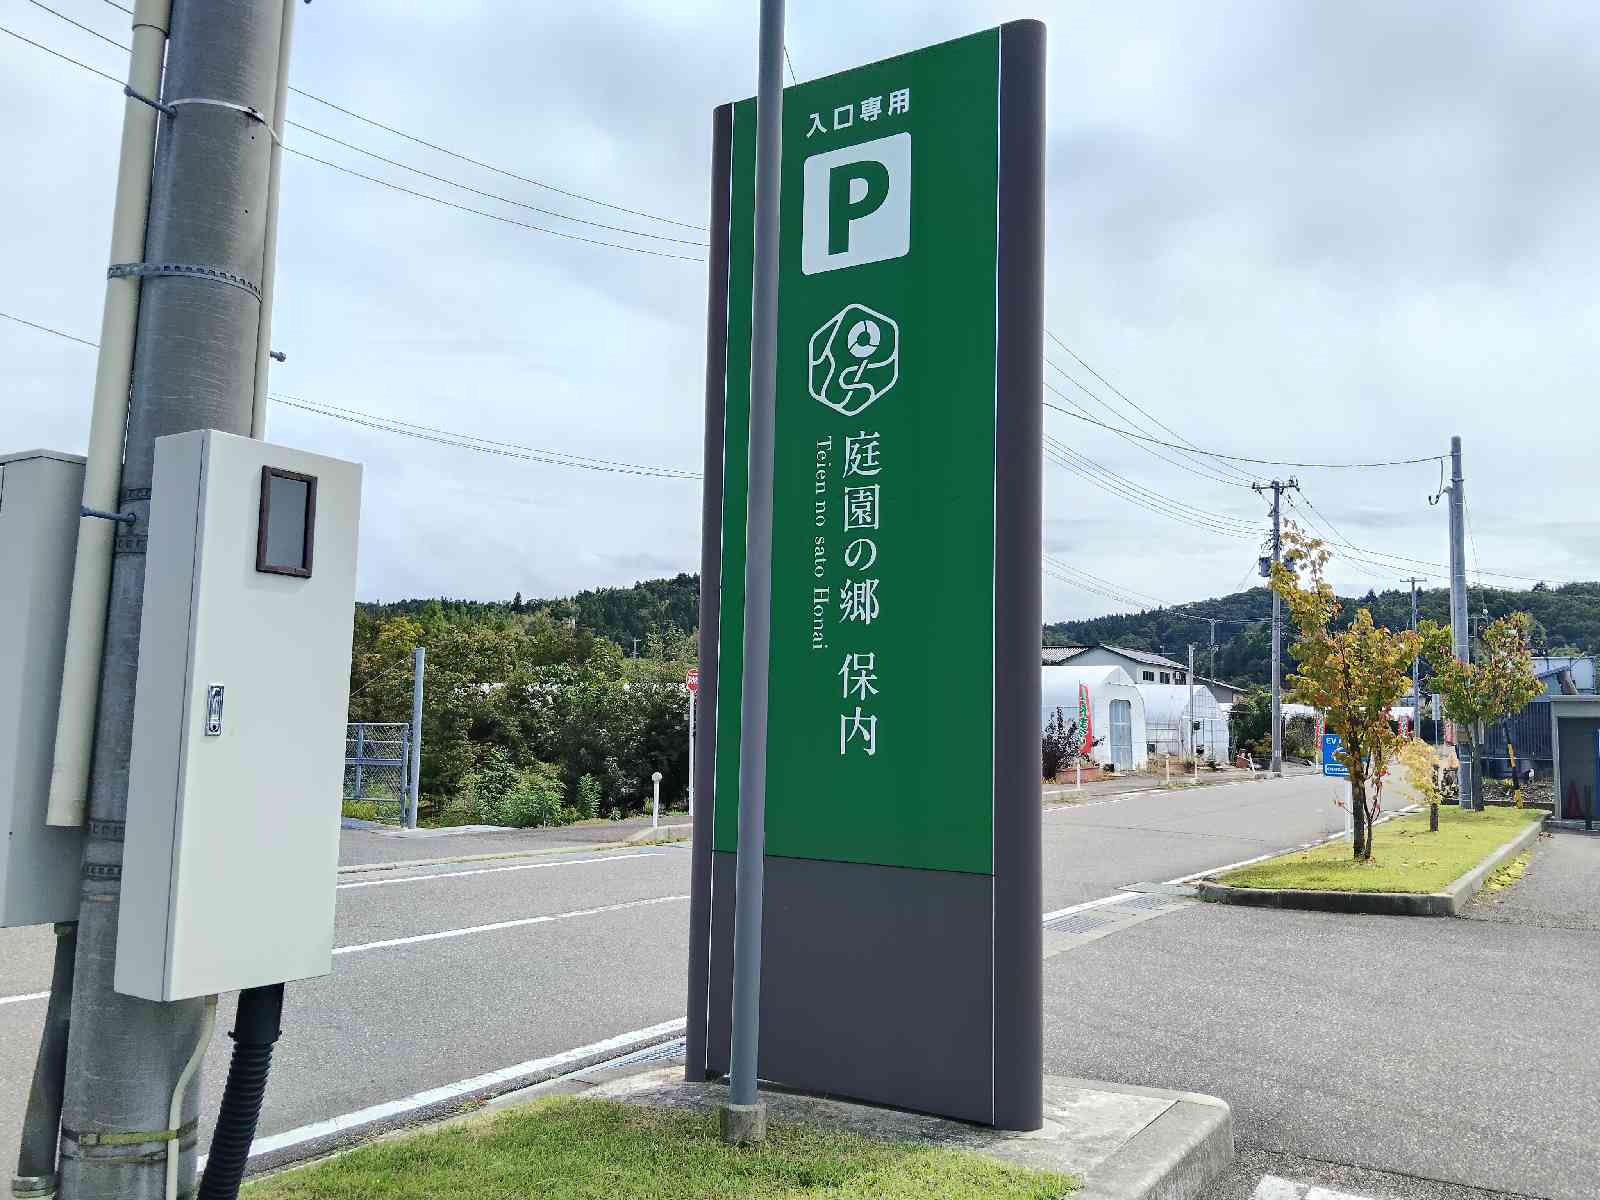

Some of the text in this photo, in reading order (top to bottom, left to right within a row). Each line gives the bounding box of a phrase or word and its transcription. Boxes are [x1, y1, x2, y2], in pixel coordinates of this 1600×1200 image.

[806, 88, 911, 138] 入口専用
[828, 161, 889, 256] P
[812, 435, 832, 649] Teien no sato Honai
[838, 430, 882, 756] 庭園の郷 保内
[1326, 737, 1337, 745] EV
